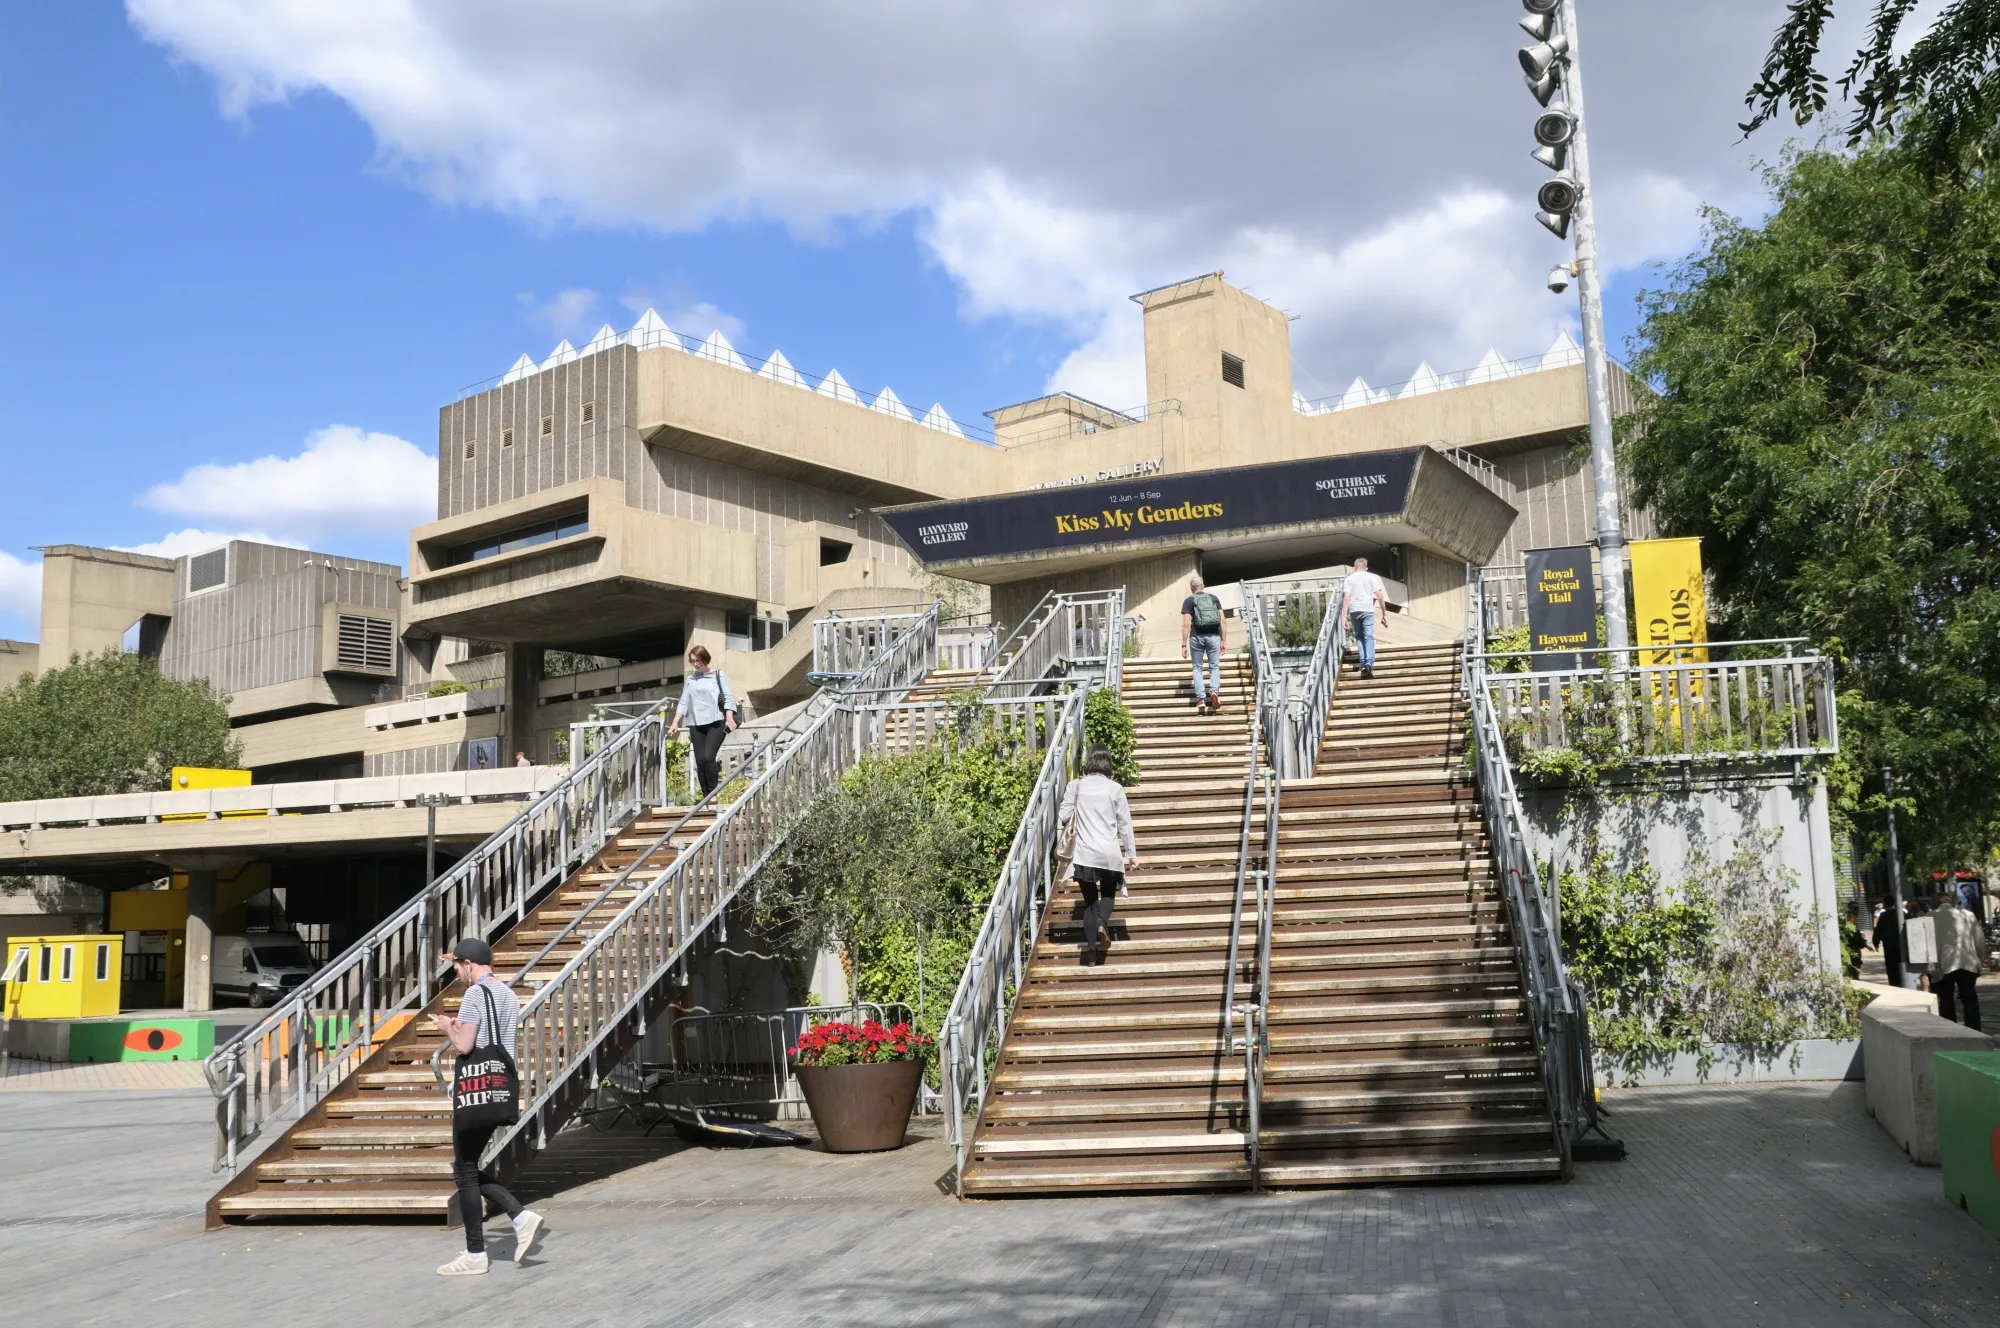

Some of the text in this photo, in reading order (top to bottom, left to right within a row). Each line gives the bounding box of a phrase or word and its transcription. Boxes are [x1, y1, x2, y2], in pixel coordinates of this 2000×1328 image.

[1095, 457, 1163, 481] GALLERY
[1315, 474, 1387, 490] SOUTHBANK
[1109, 495, 1118, 503] 12
[1118, 494, 1132, 503] Jun
[1140, 492, 1145, 500] 8
[1146, 491, 1161, 500] Sep
[1330, 486, 1376, 499] CENTRE
[1055, 501, 1223, 534] Kiss My Genders
[918, 521, 969, 536] HAYWARD
[922, 531, 967, 545] GALLERY
[1543, 567, 1574, 581] Royal
[1539, 579, 1580, 592] Festival
[1548, 592, 1572, 603] Hall
[1538, 631, 1588, 646] Hayward
[459, 1060, 490, 1079] MIF
[458, 1075, 491, 1095] MIF
[456, 1090, 492, 1109] MIF
